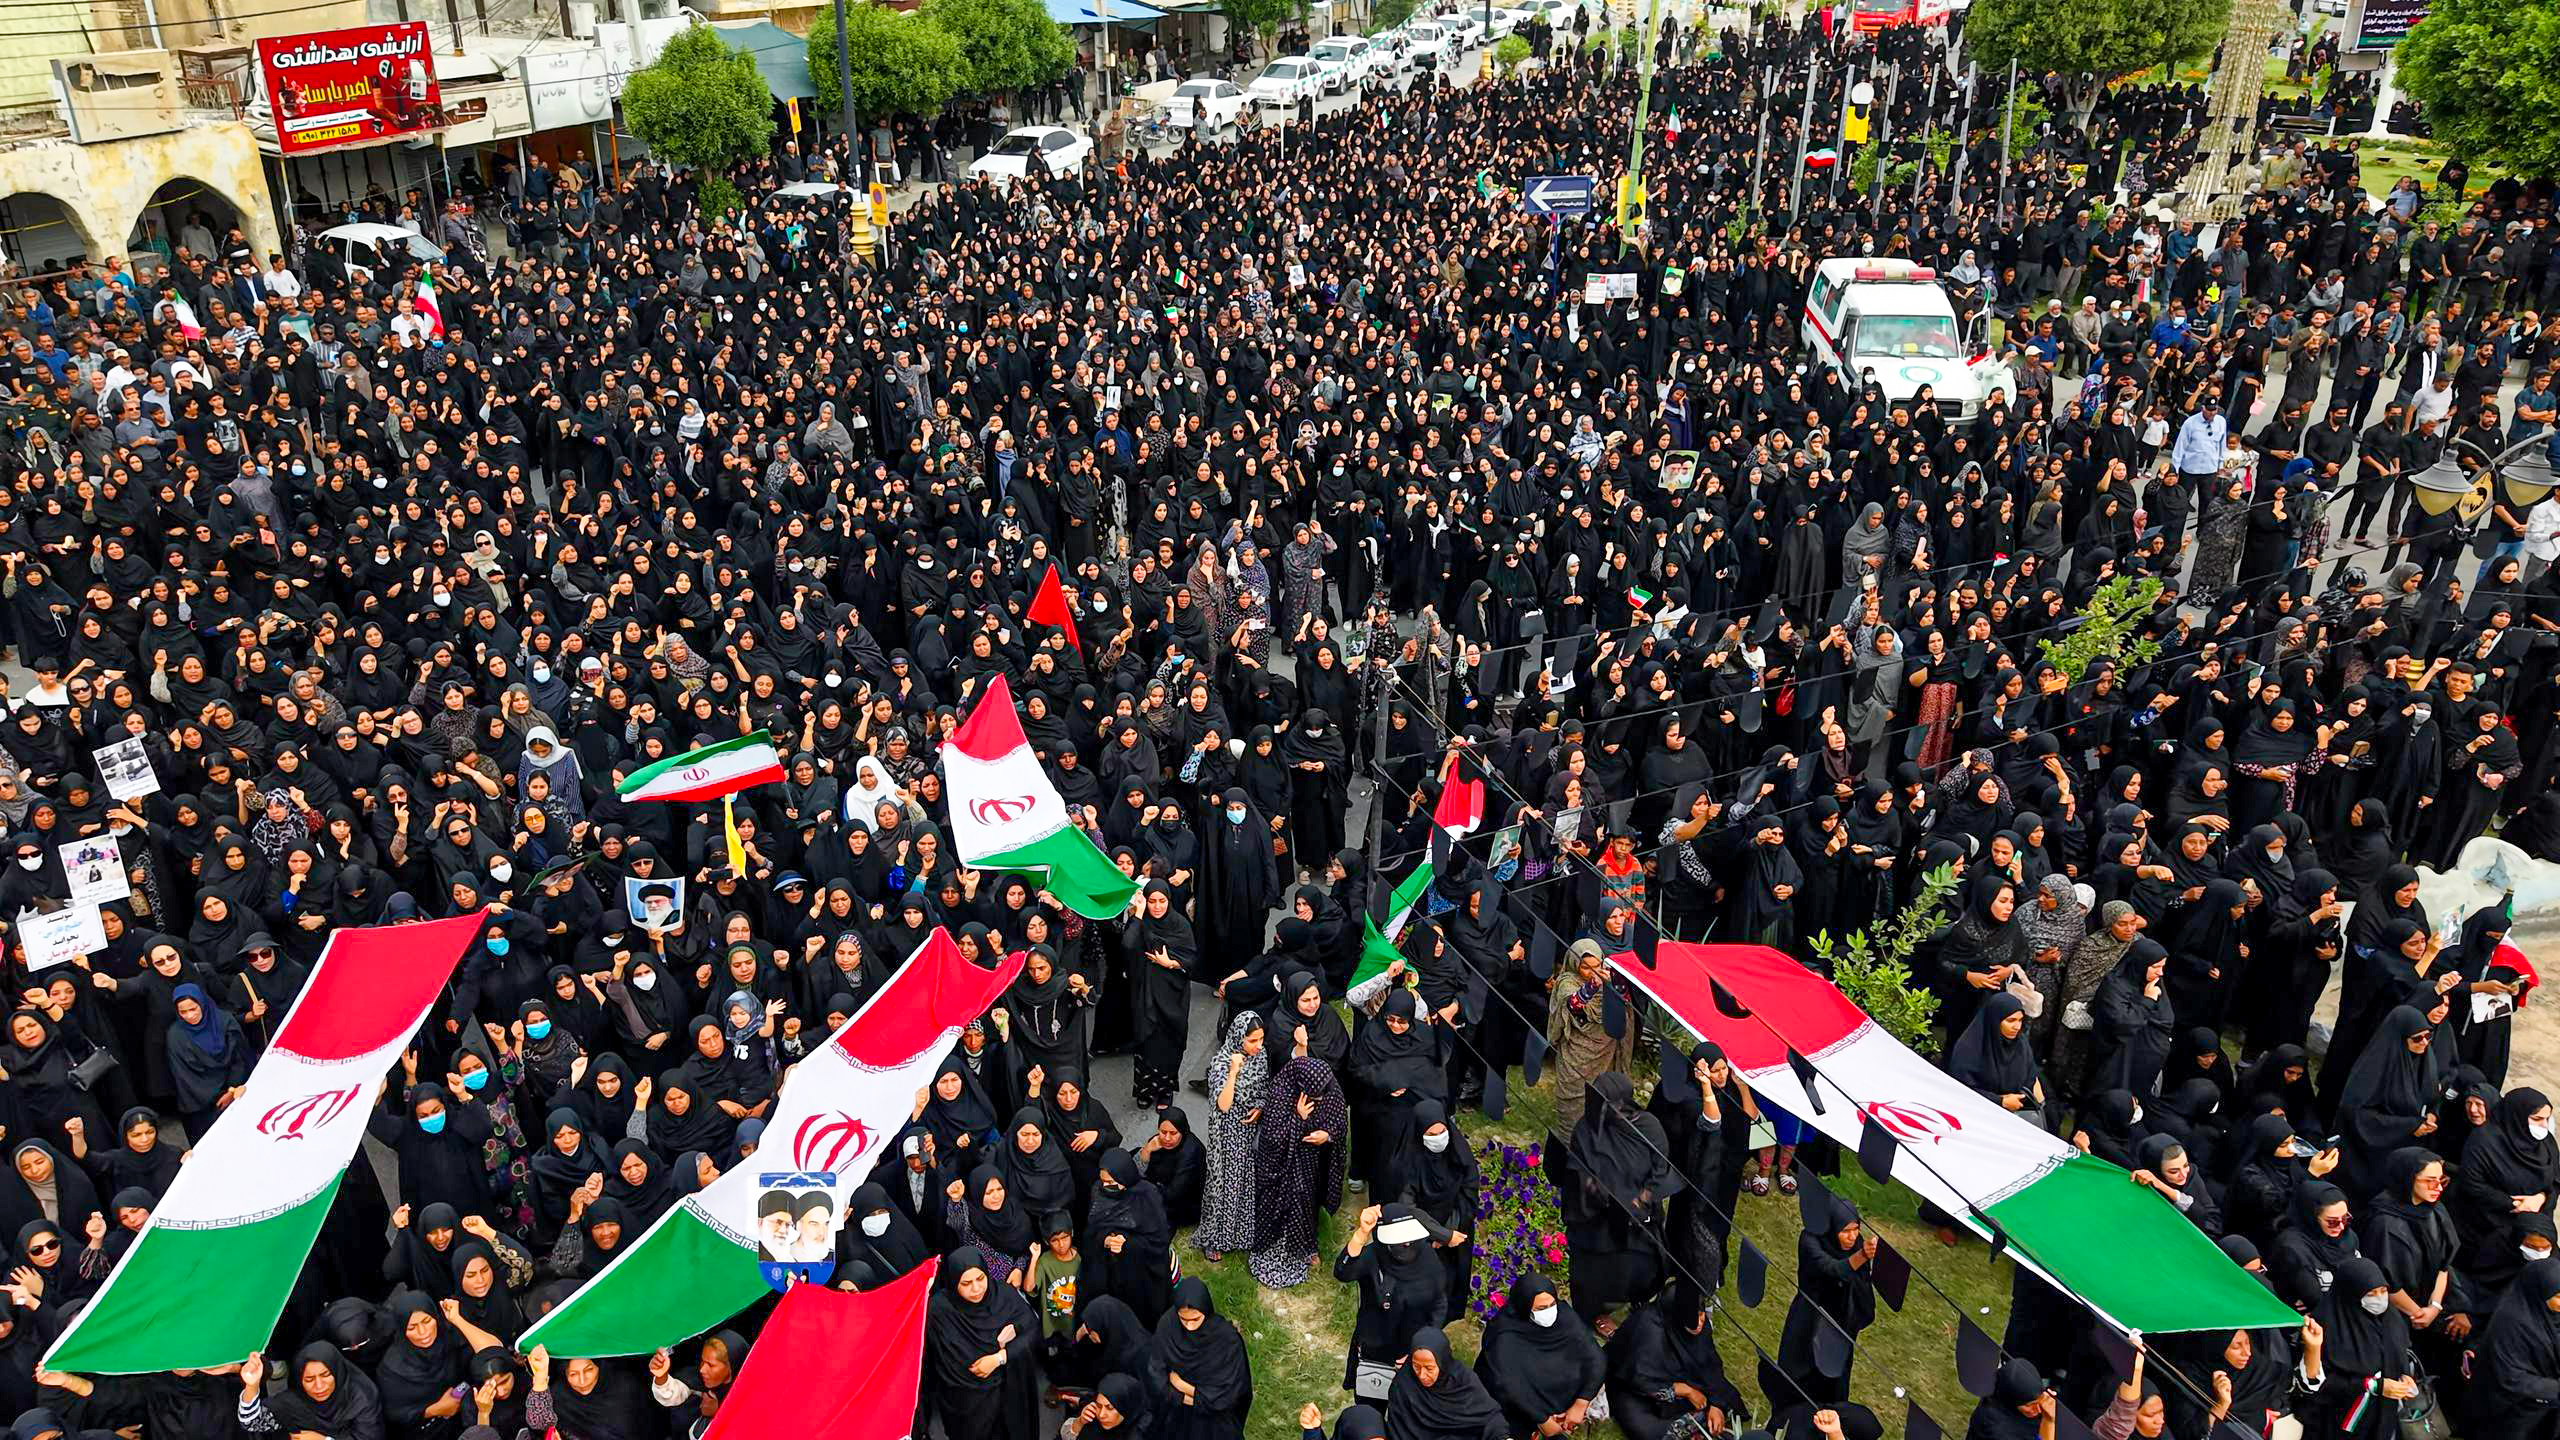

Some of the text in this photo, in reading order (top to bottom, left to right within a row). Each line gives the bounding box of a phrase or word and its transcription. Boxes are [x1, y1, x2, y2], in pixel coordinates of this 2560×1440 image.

[272, 30, 423, 68] آرایشی بهداشتی
[304, 75, 372, 106] امیر پارسا
